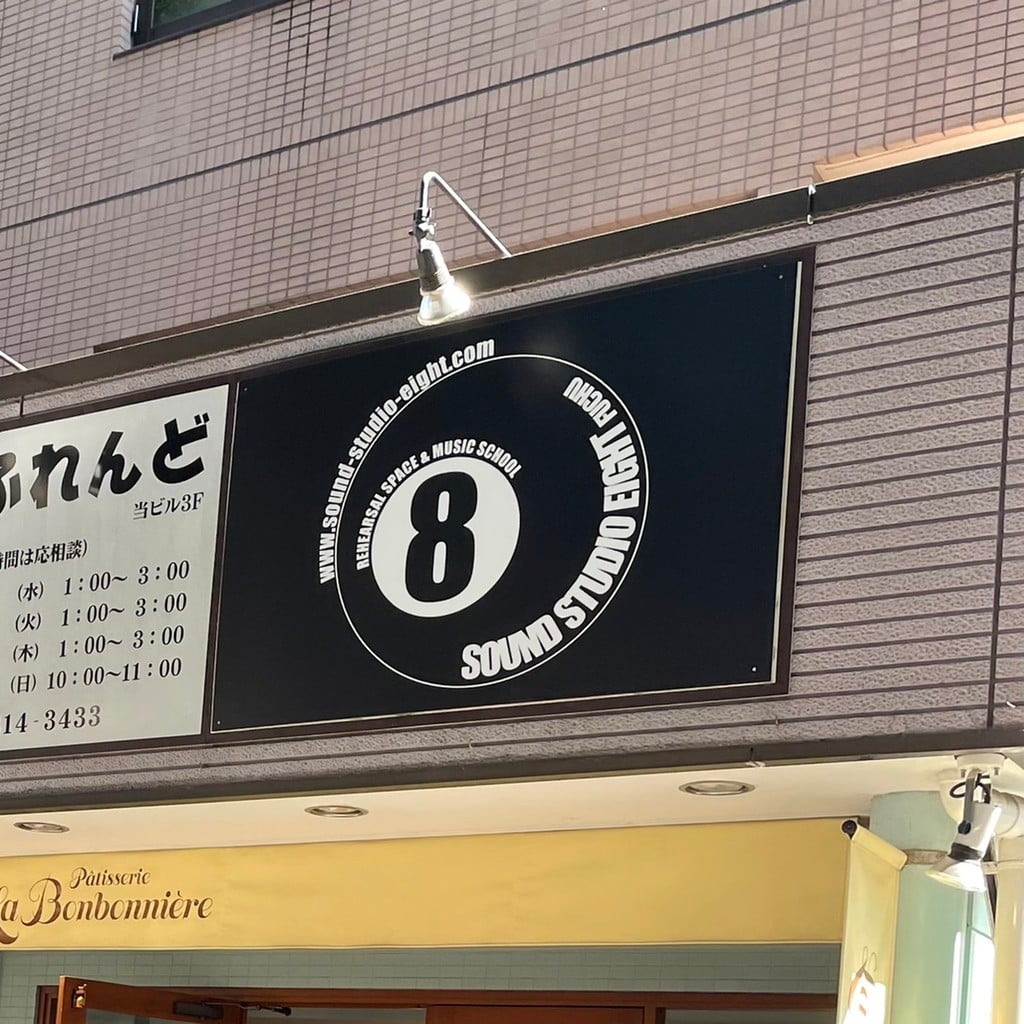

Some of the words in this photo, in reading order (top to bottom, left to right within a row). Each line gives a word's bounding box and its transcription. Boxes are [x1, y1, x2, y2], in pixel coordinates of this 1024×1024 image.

[562, 376, 618, 428] FUCHU
[589, 421, 641, 513] EIGHT
[132, 492, 205, 520] 当ビル3F
[356, 493, 387, 571] REHEARSAL
[381, 458, 420, 496] SPACE
[419, 451, 432, 464] &
[432, 438, 476, 460] MUSIC
[476, 440, 523, 480] SCHOOL
[404, 470, 478, 604] 8
[553, 515, 637, 629] STUDIO
[460, 614, 563, 680] SOUND
[20, 877, 214, 927] Bonbonnière
[69, 866, 151, 889] Pâtisserie
